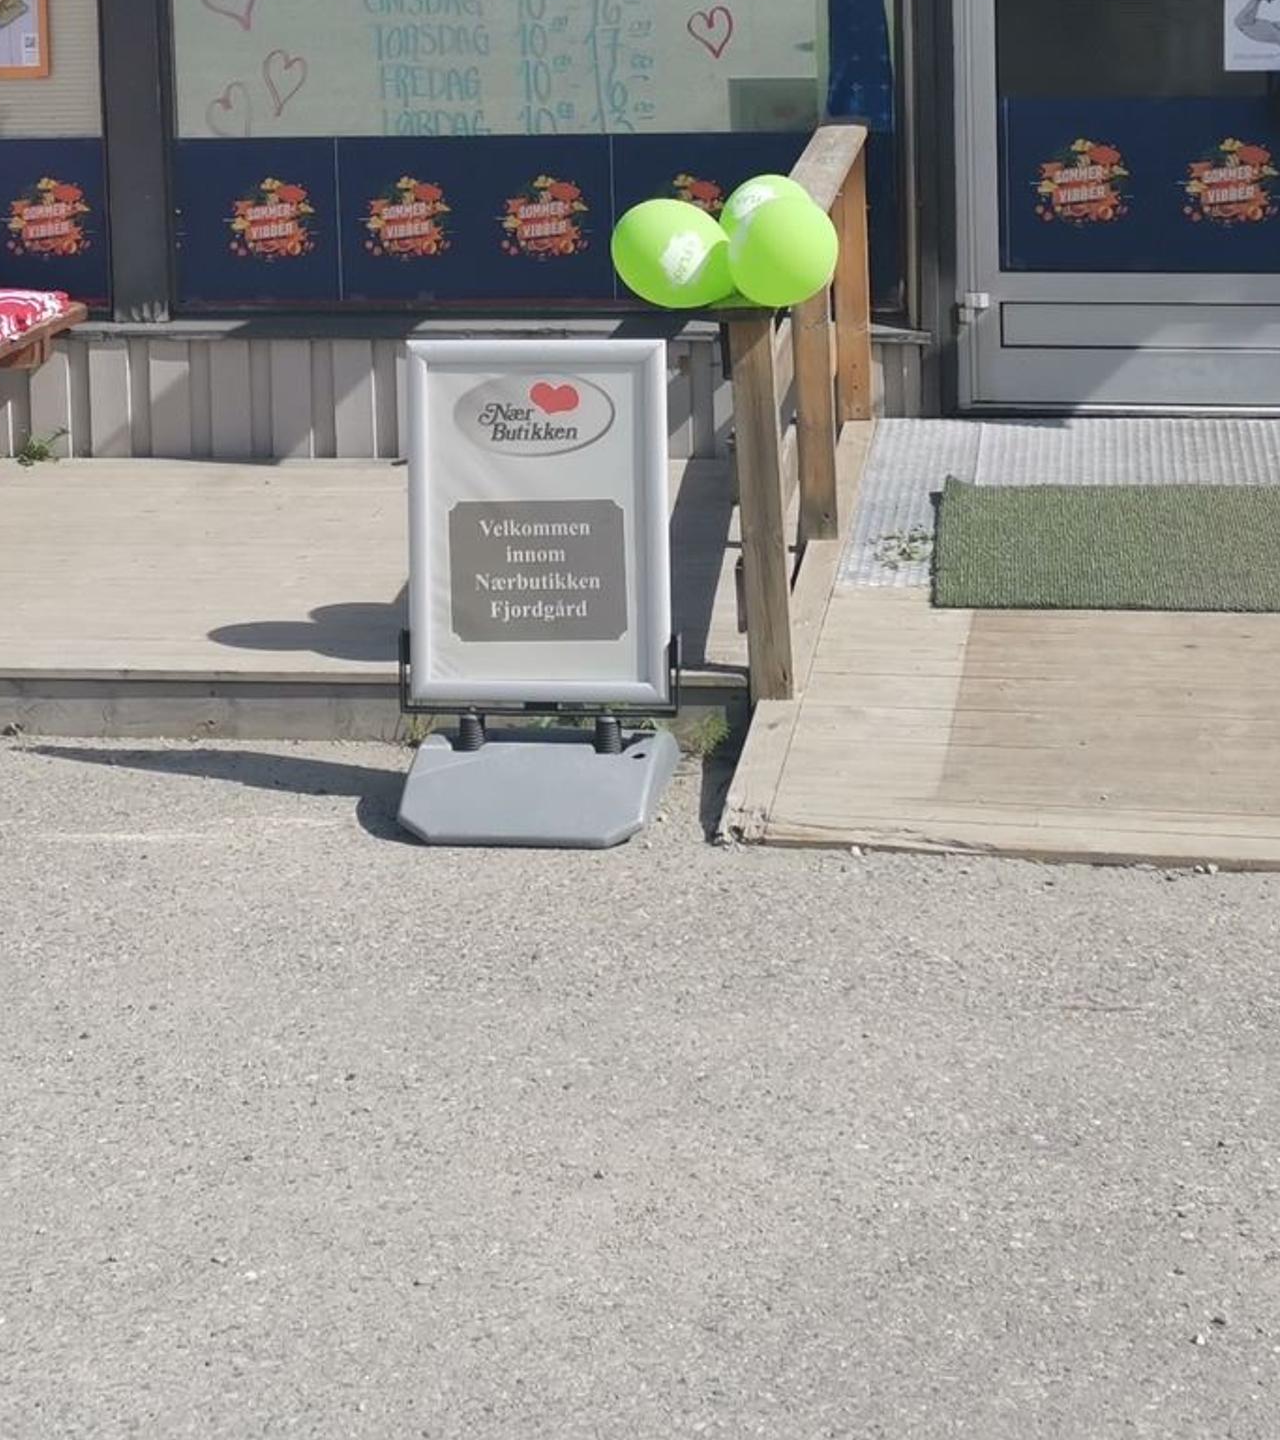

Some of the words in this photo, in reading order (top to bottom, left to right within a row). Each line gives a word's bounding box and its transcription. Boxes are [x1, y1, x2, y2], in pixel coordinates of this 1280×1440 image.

[478, 402, 535, 426] Nær
[490, 423, 578, 442] Butikken
[478, 519, 591, 537] Velkommen
[506, 545, 566, 563] innom
[475, 572, 601, 591] Nærbutikken
[490, 599, 588, 622] Fjordgård
